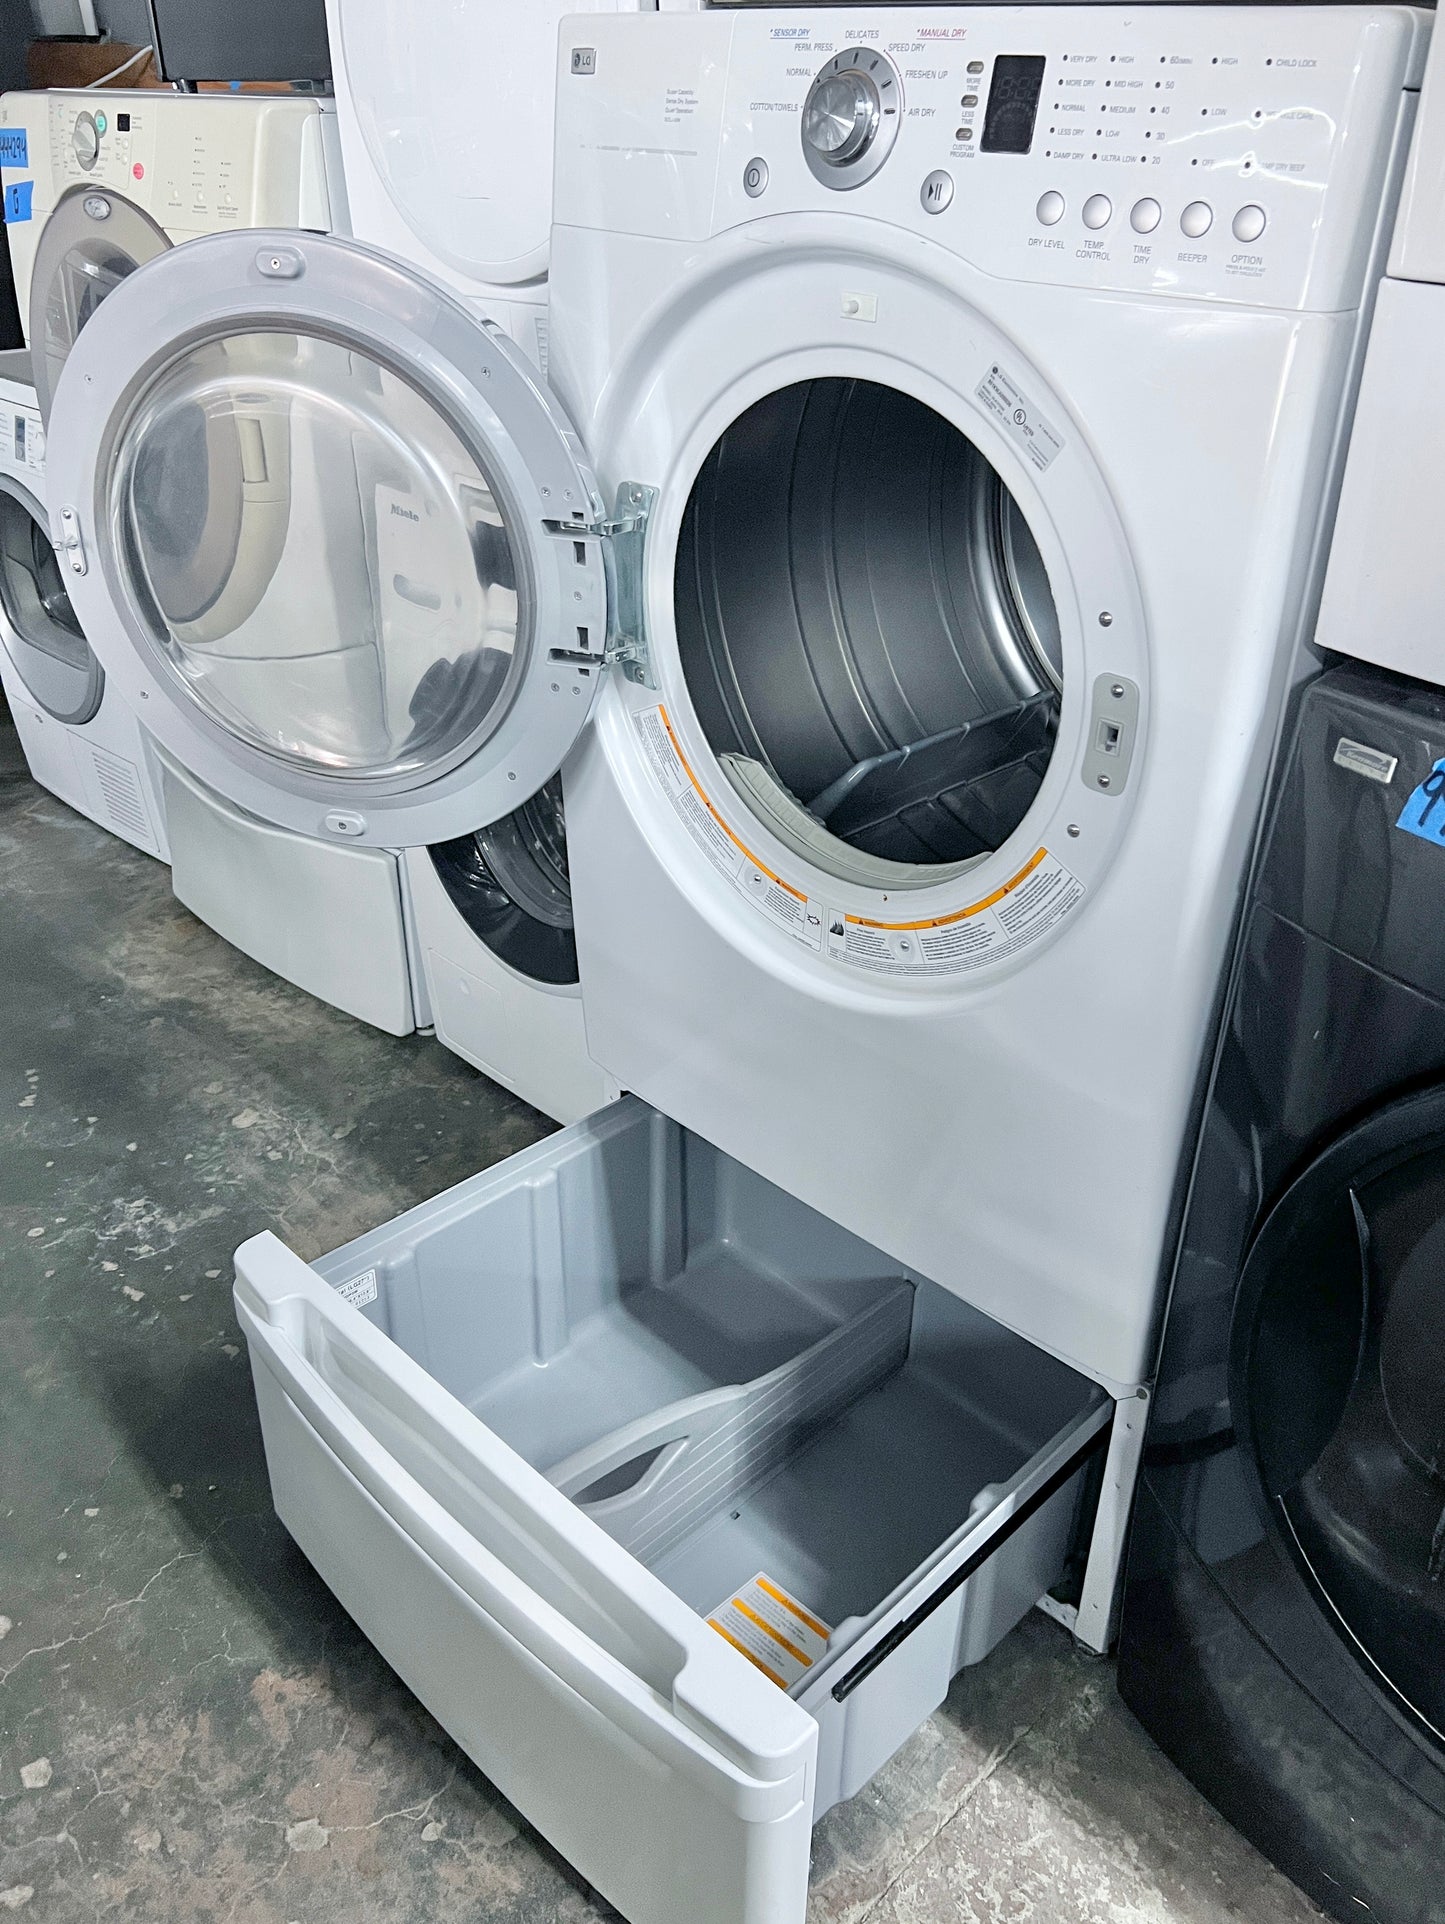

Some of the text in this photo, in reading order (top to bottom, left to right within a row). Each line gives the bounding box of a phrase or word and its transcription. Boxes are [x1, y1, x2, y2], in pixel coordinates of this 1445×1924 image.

[797, 28, 811, 36] DRY
[845, 30, 879, 39] DELICATES
[950, 28, 967, 38] DRY
[814, 43, 834, 51] PRESS
[888, 43, 926, 52] SPEED DRY
[1276, 58, 1317, 68] CHILD LOCK
[786, 68, 812, 77] NORMAL
[904, 70, 948, 79] FRESHEN UP
[1165, 81, 1175, 90] 50
[750, 102, 798, 112] COTTON/TOWELS
[1061, 104, 1086, 112] NORMAL
[1109, 106, 1137, 114] MEDIUM
[1161, 106, 1170, 115] 40
[908, 108, 936, 118] AIR DRY
[961, 110, 975, 118] LESS
[1210, 108, 1228, 116] LOW
[1057, 128, 1072, 136] LESS
[1105, 130, 1121, 138] LOW
[950, 151, 976, 159] PROGRAM
[1053, 152, 1085, 160] DAMP DRY
[1101, 154, 1138, 164] ULTRA LOW
[1152, 156, 1161, 165] 20
[1028, 238, 1065, 250] DRY LEVEL
[1133, 244, 1152, 255] TIME
[1075, 250, 1111, 261] CONTROL
[1133, 256, 1150, 264] DRY
[1177, 252, 1208, 263] BEEPER
[1231, 254, 1263, 266] OPTION
[390, 503, 420, 523] Miele
